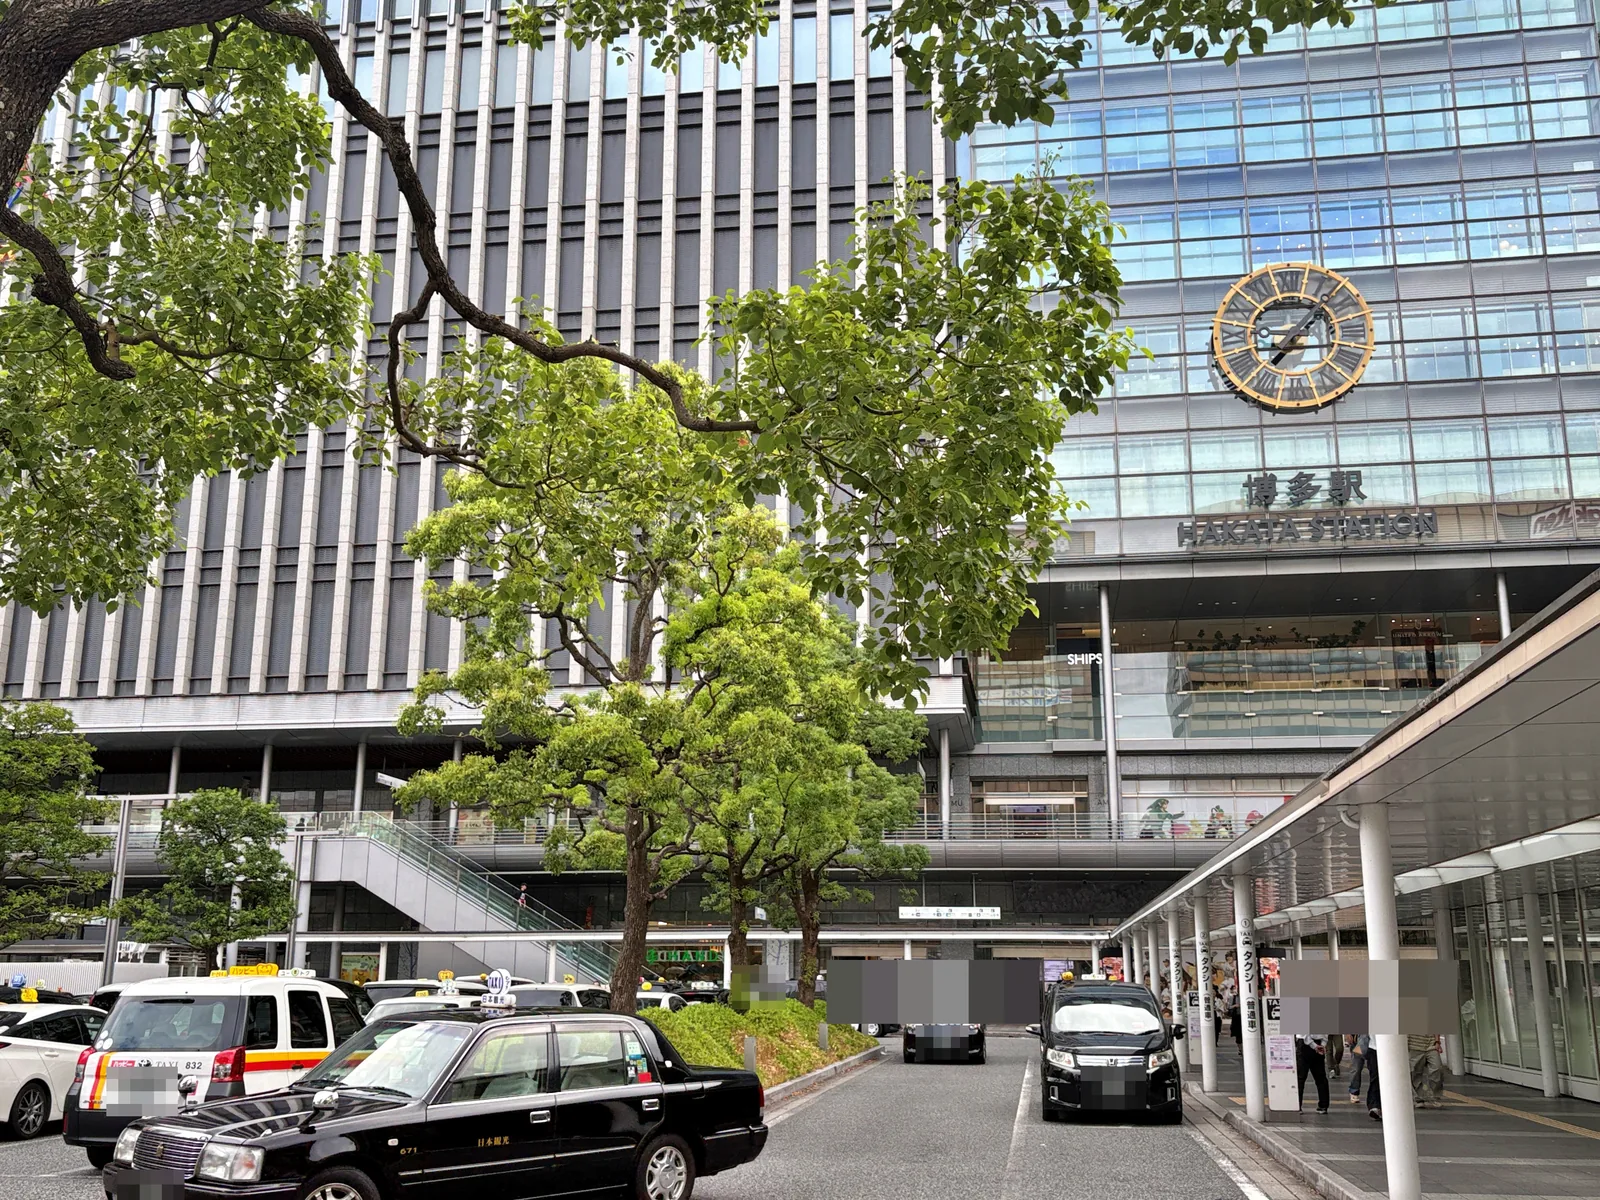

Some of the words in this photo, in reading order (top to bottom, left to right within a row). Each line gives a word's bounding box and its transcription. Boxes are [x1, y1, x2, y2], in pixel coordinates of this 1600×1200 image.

[1242, 470, 1367, 509] 博多駅
[1178, 517, 1301, 546] HAKATA
[1309, 511, 1438, 541] STATION
[1067, 653, 1103, 665] SHIPS
[231, 967, 255, 976] ハッピー
[185, 1061, 203, 1070] 832
[400, 1146, 417, 1155] 671
